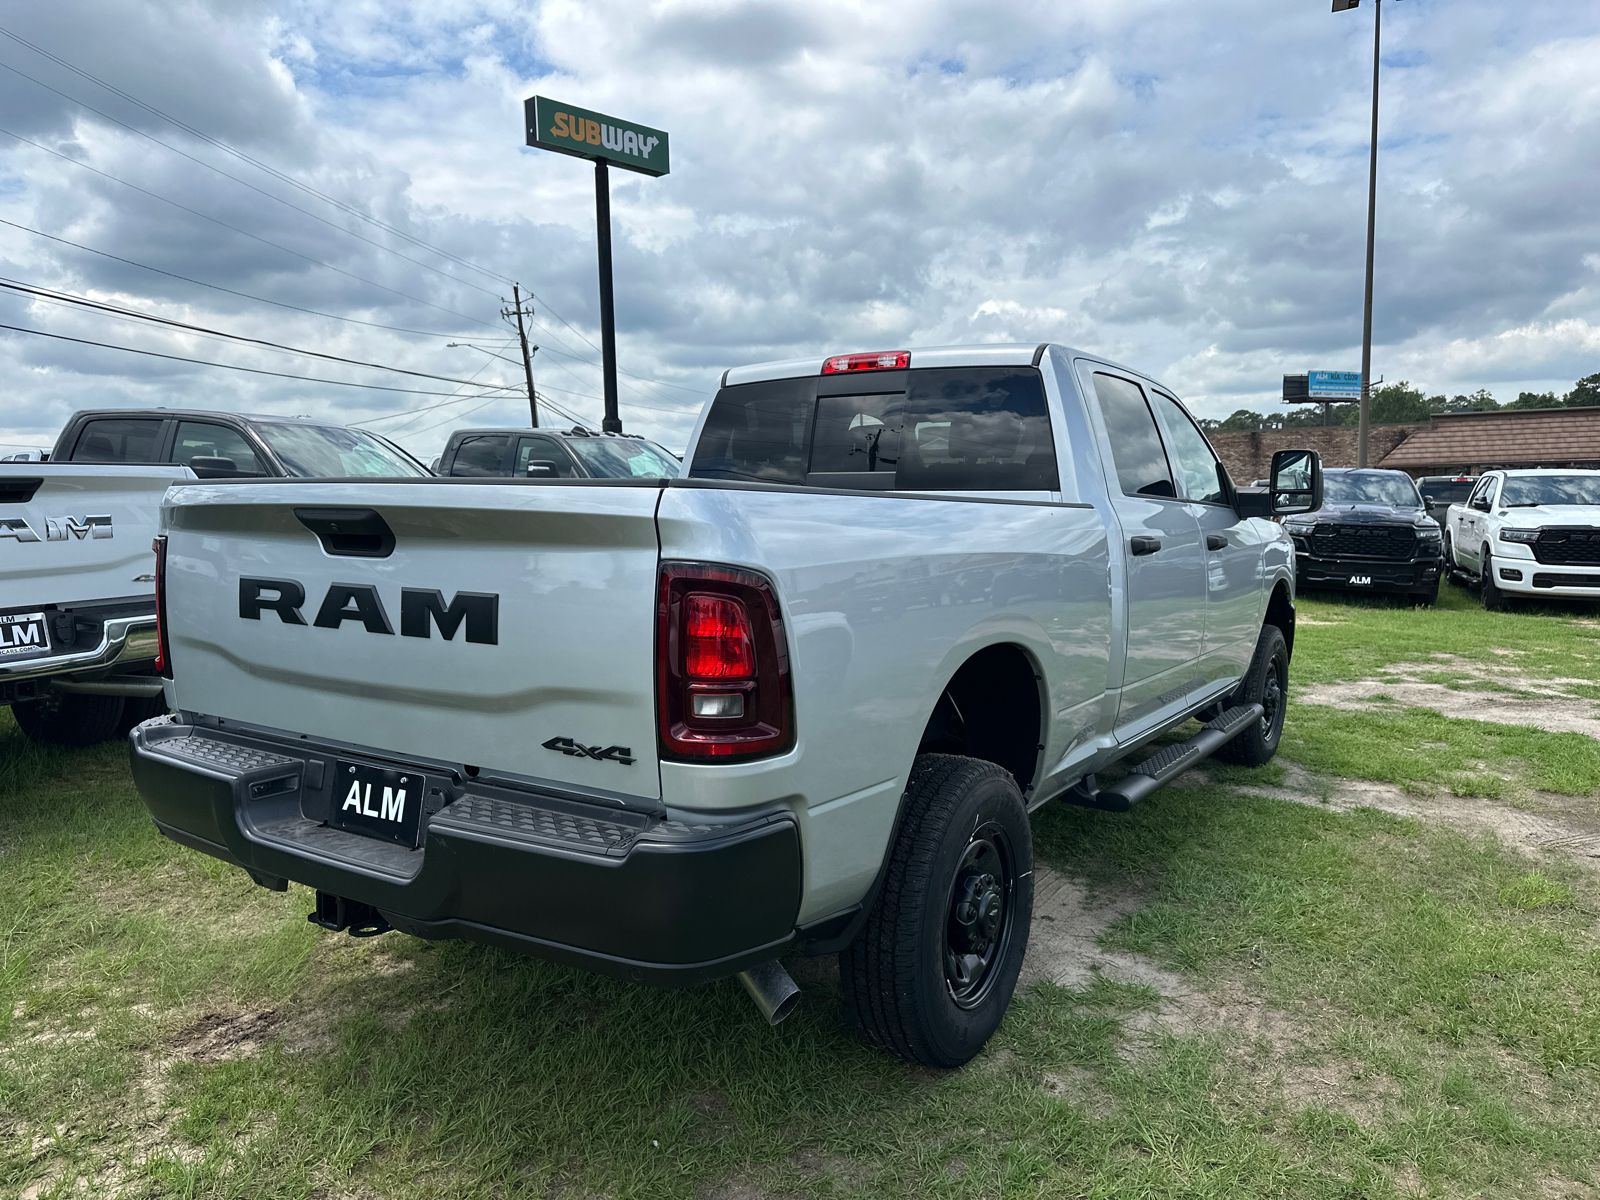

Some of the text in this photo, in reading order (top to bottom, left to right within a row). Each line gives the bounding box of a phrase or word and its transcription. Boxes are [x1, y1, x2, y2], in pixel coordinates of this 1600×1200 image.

[550, 111, 660, 159] SUBWAY
[1340, 529, 1389, 537] RAM
[1349, 575, 1371, 585] ALM
[0, 615, 15, 624] LM
[239, 574, 500, 646] RAM
[342, 780, 407, 823] ALM
